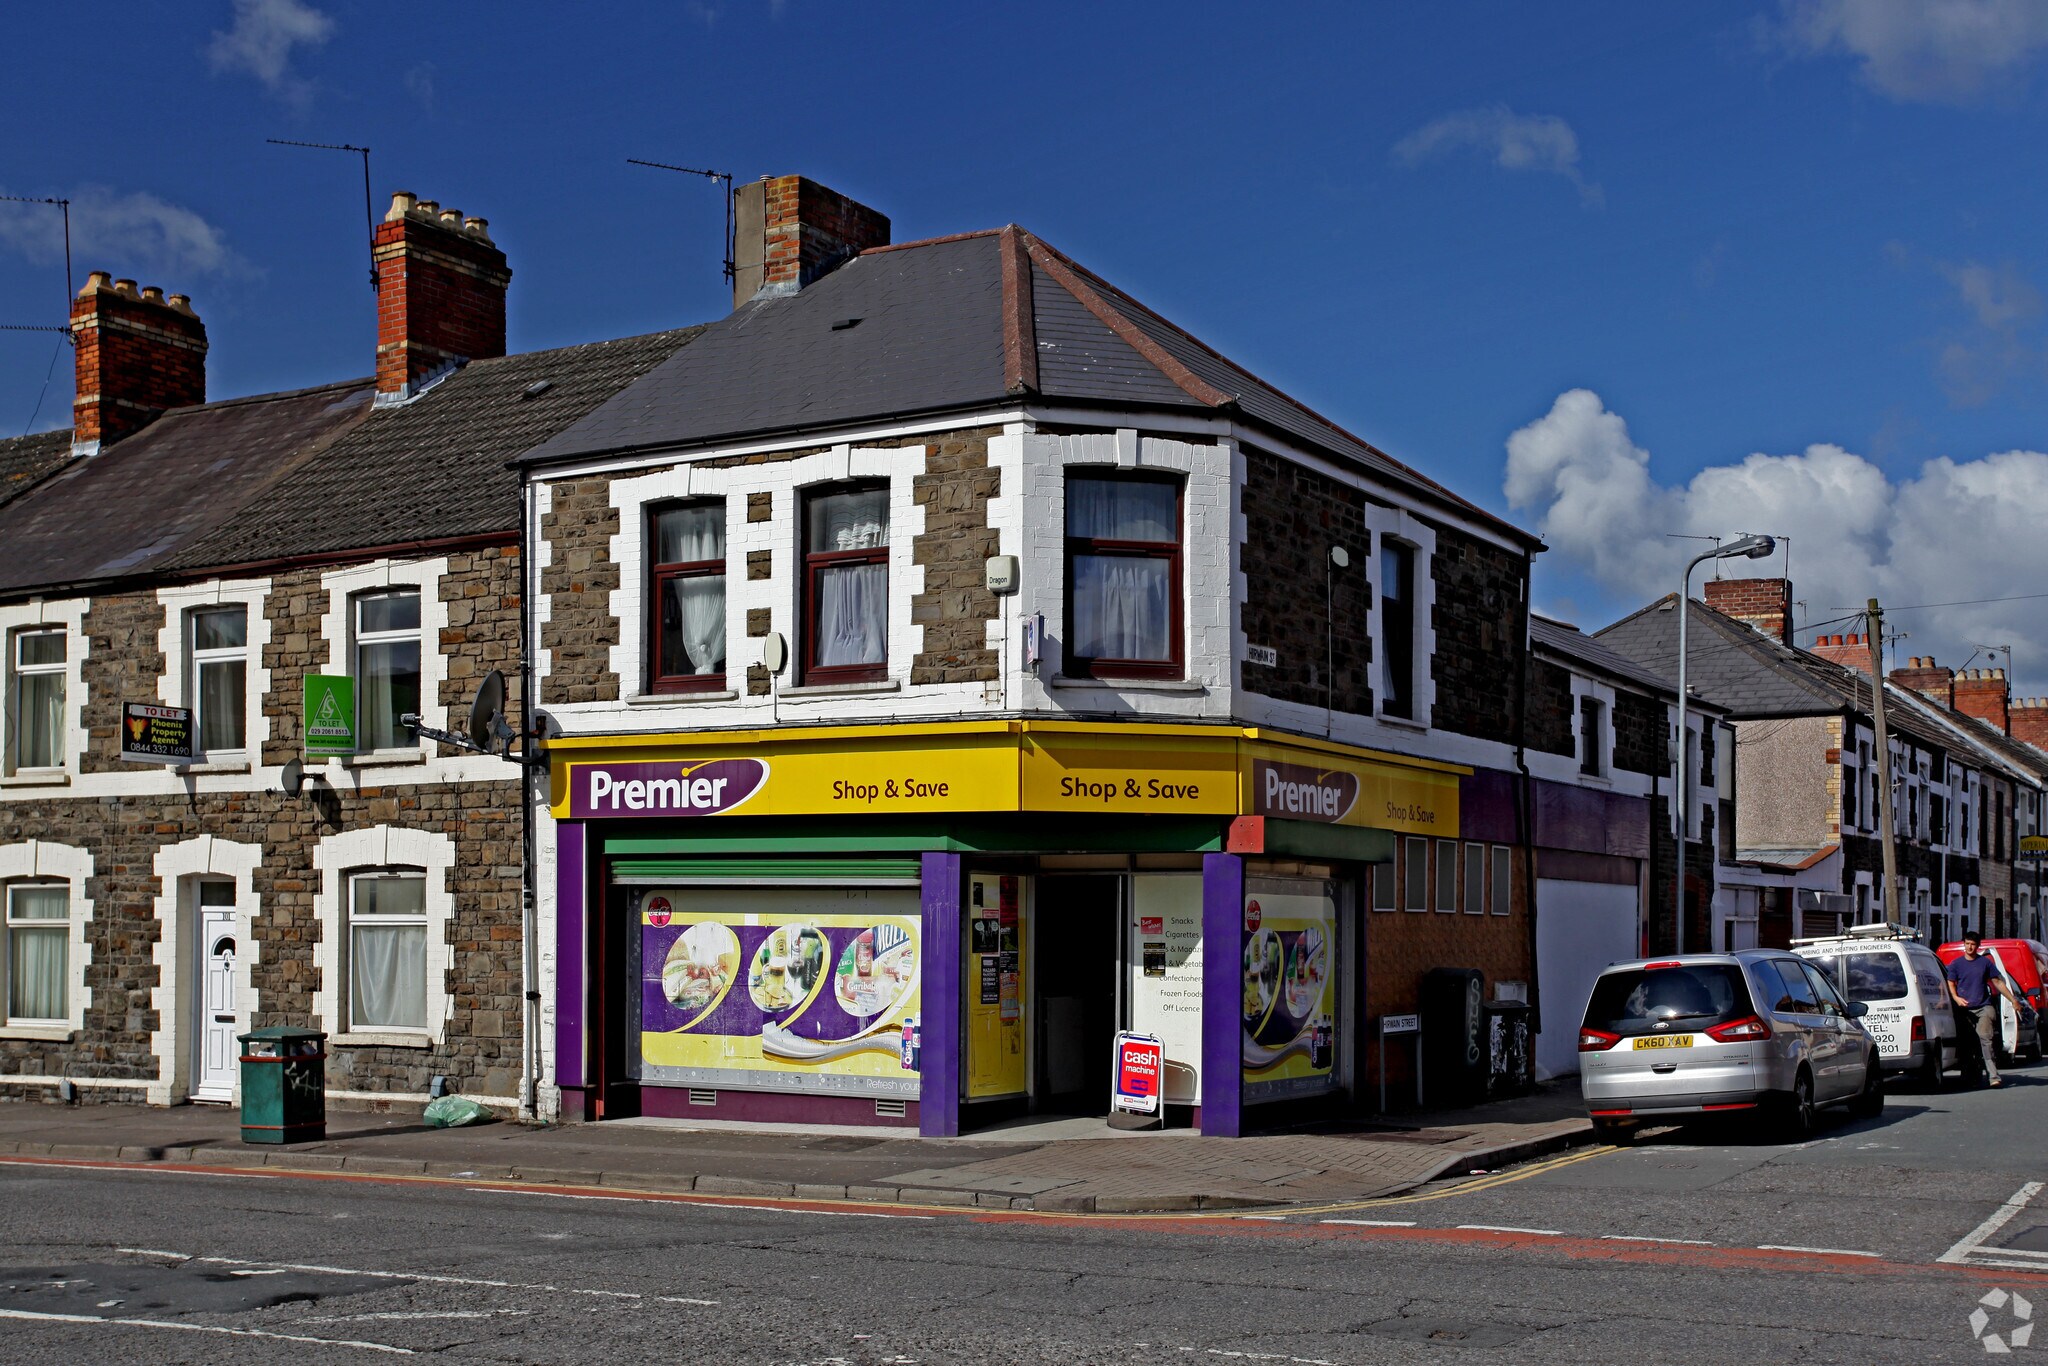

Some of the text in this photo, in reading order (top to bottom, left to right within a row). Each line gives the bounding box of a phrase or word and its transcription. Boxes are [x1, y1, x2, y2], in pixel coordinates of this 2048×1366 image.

[989, 577, 1008, 585] Dragon
[144, 707, 178, 718] TO LET
[151, 719, 183, 729] Phoenix
[151, 727, 187, 740] Property
[151, 735, 179, 745] Agents
[130, 742, 189, 755] 0844 332 1690
[590, 768, 728, 810] Premier
[833, 778, 949, 804] Shop & Save
[1060, 777, 1200, 803] Shop & Save
[1265, 767, 1341, 817] Premier
[1386, 801, 1435, 824] Shop & Save
[1171, 917, 1194, 925] Snacks
[1165, 930, 1200, 939] Cigarettes
[1860, 943, 1892, 951] ENGINEERS
[1160, 989, 1203, 998] Frozen Foods
[1163, 1003, 1200, 1012] Off Licence
[1401, 1017, 1416, 1028] STREET
[1867, 1024, 1888, 1033] TEL:
[1636, 1037, 1665, 1049] CK60
[1872, 1034, 1895, 1043] 920
[1124, 1049, 1158, 1066] cash
[1125, 1065, 1155, 1076] machine
[866, 1078, 898, 1090] Refresh
